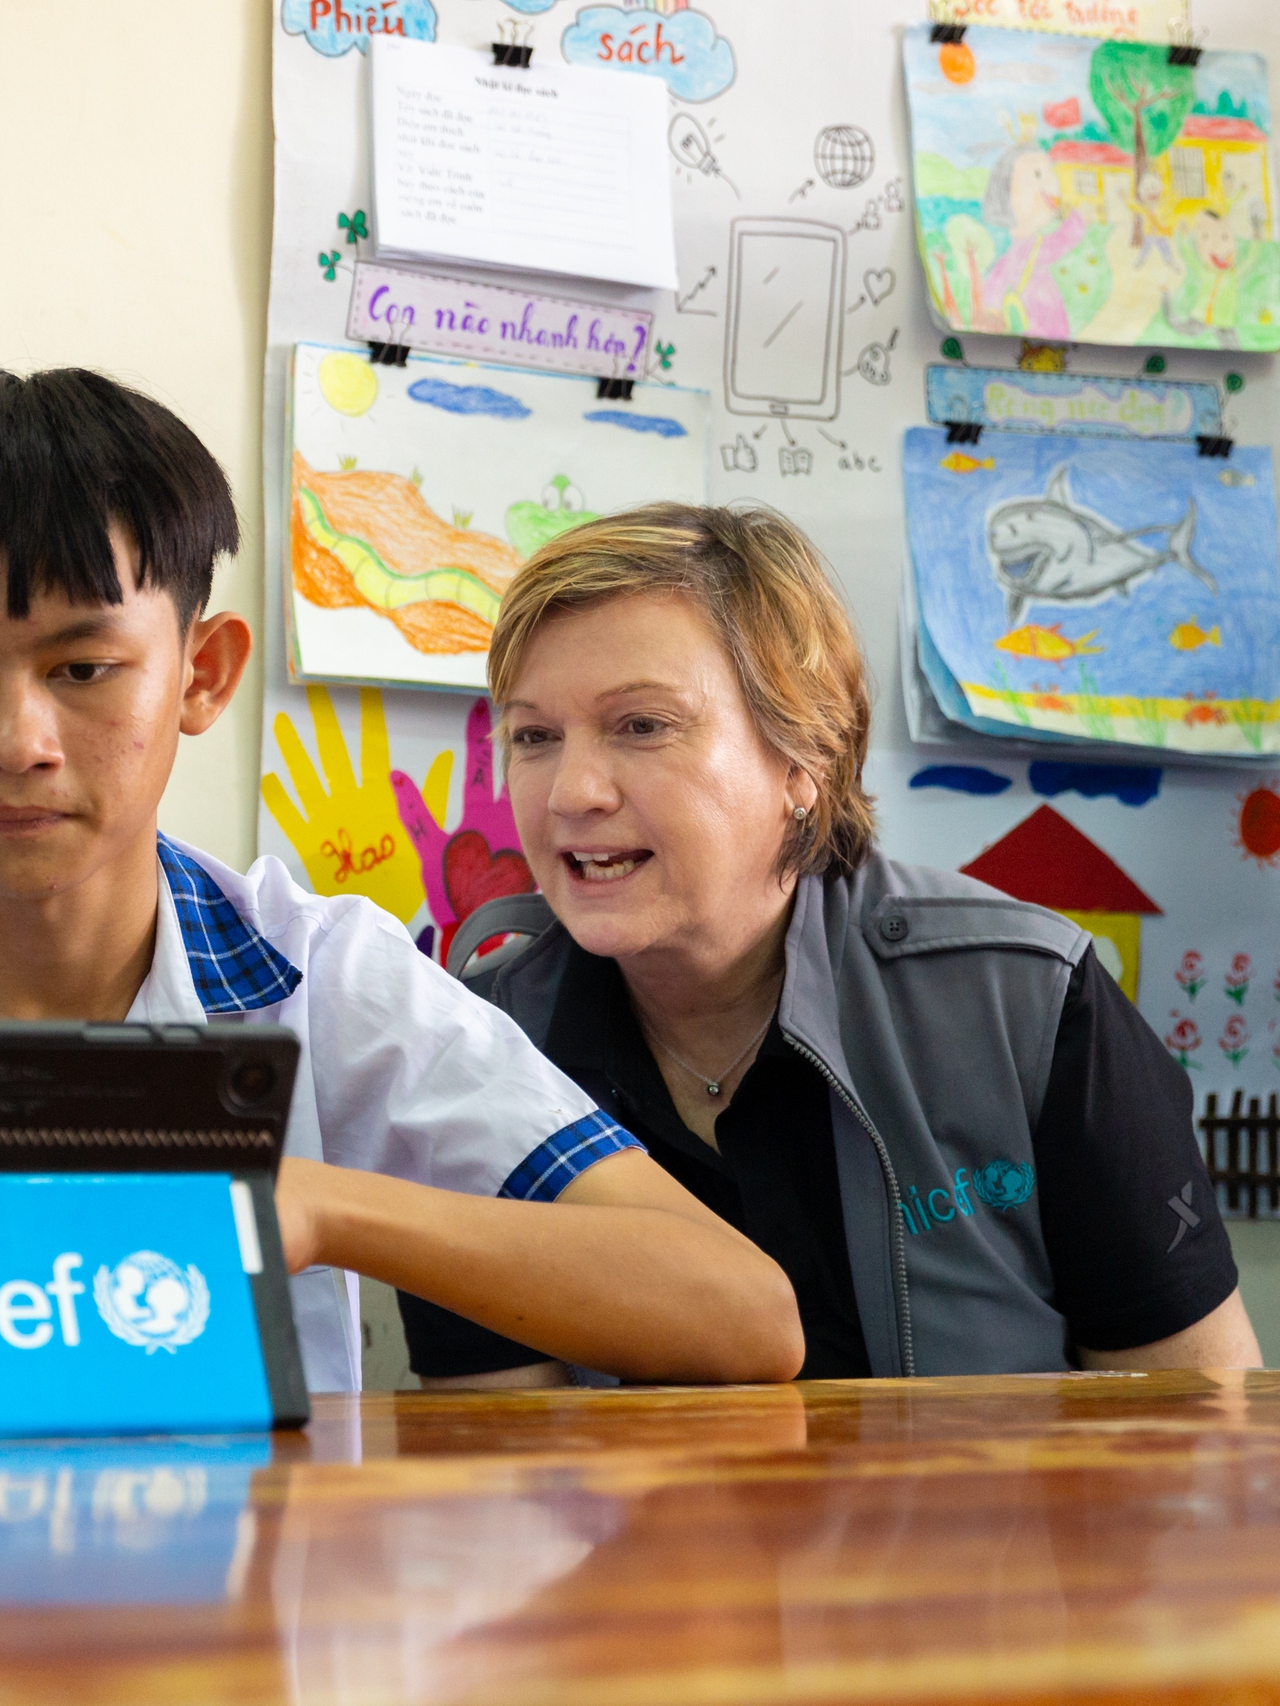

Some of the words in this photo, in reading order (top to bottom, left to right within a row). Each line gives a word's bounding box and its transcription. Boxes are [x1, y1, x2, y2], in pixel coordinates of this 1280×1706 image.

[597, 22, 685, 65] sách
[369, 285, 416, 326] Con
[500, 302, 578, 350] nhanh
[838, 450, 883, 473] abc
